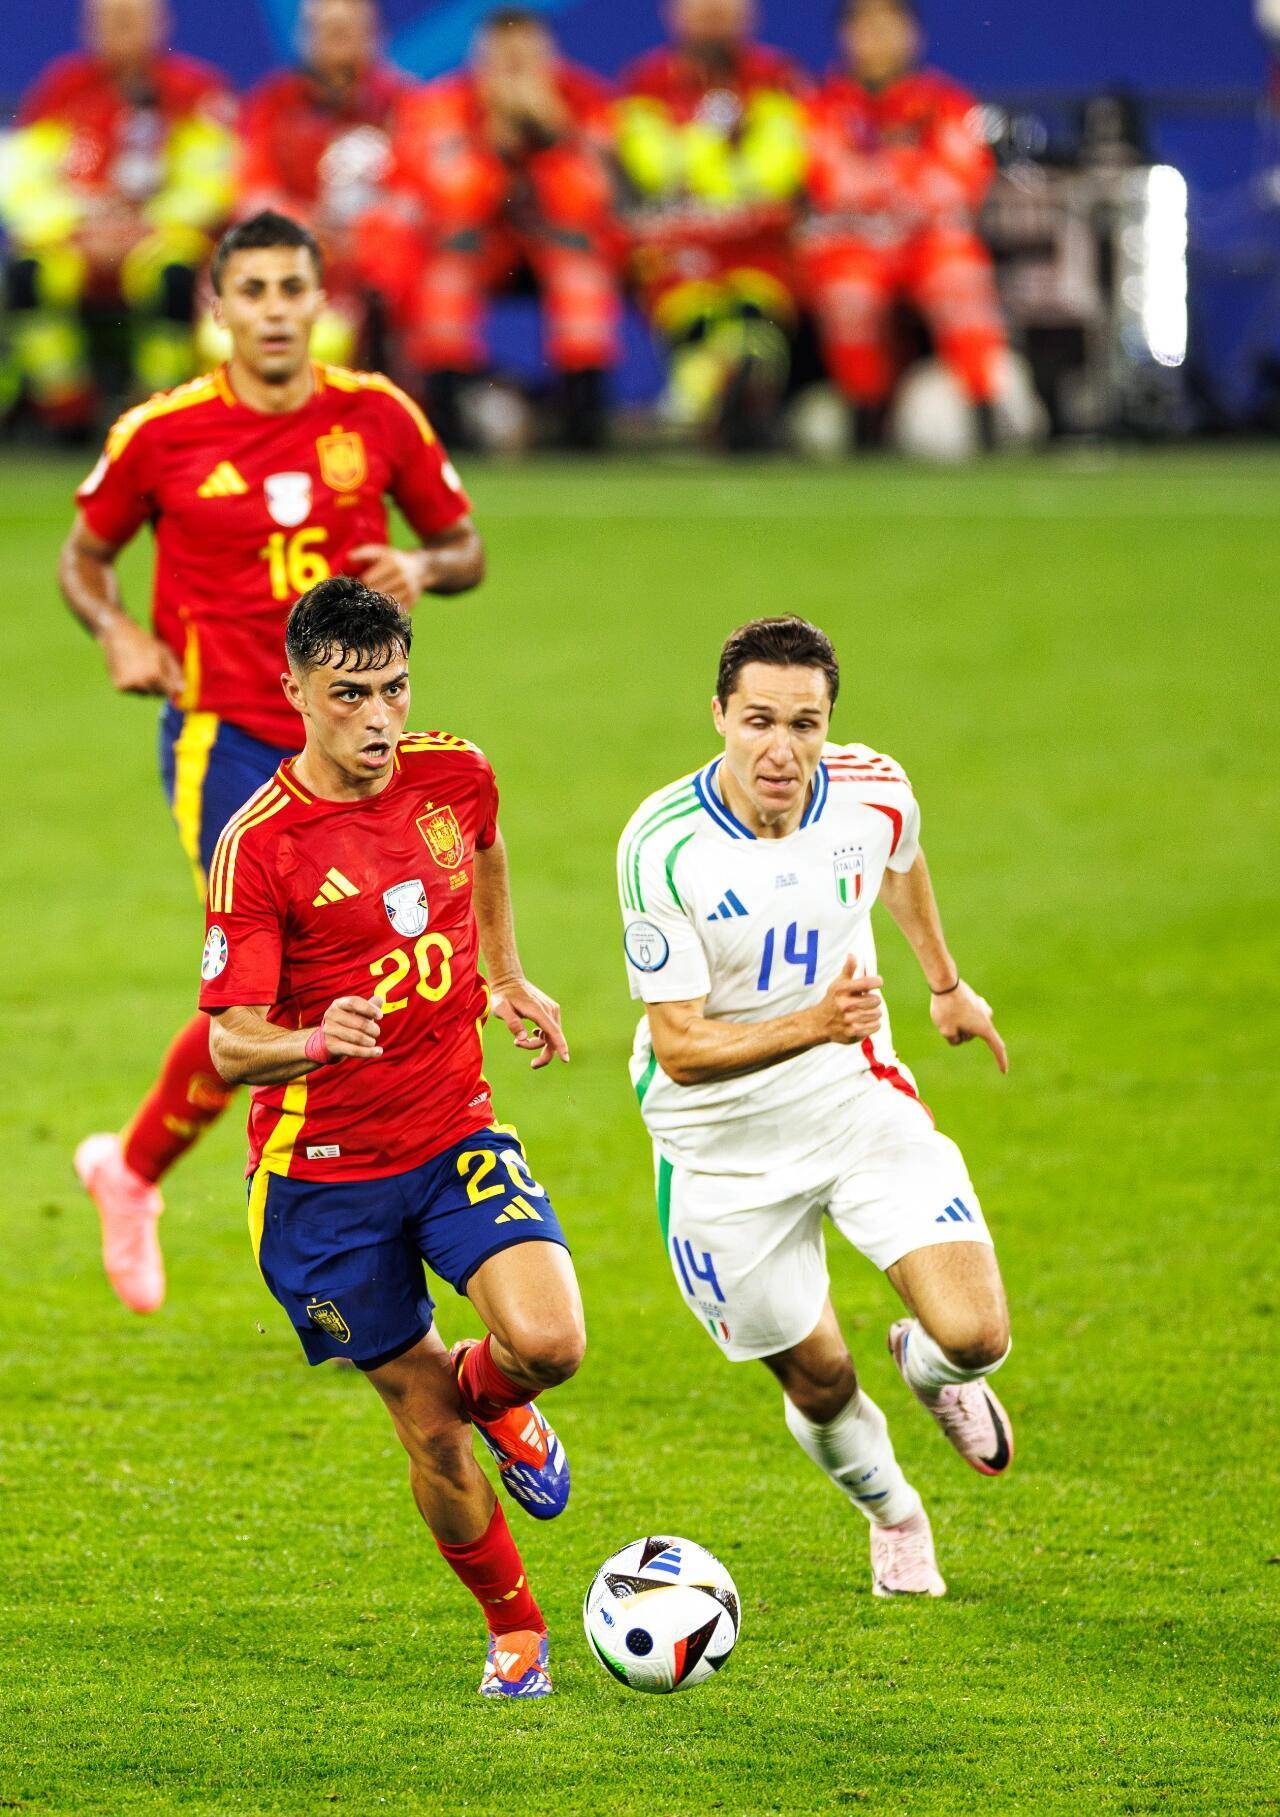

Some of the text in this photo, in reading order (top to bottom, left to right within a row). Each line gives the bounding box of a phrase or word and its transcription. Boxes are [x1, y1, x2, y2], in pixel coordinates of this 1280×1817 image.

[260, 527, 332, 600] 16
[835, 859, 861, 872] ITALIA
[369, 932, 454, 1015] 20
[757, 921, 819, 991] 14
[673, 1236, 726, 1303] 14
